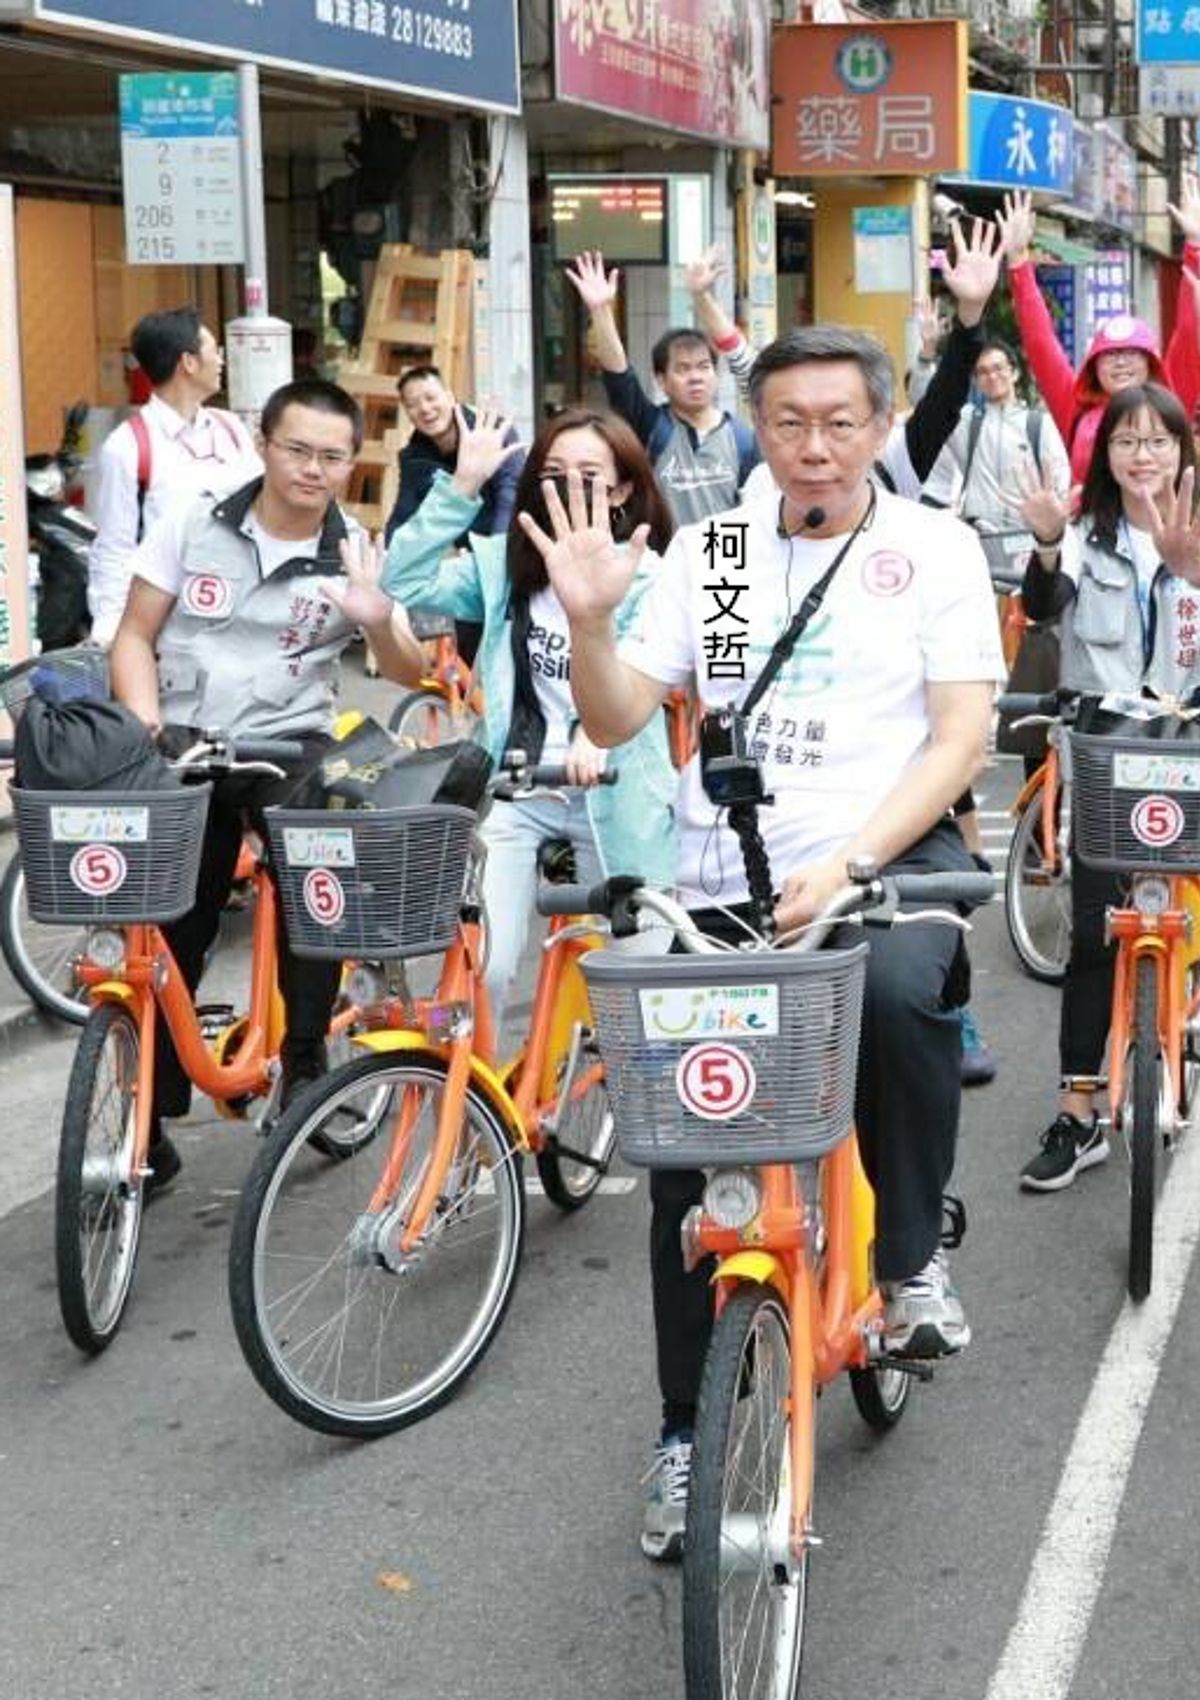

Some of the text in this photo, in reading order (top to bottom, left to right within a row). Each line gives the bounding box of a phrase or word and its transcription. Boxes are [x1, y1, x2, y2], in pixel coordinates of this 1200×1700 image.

[797, 95, 935, 162] 藥局
[158, 142, 170, 164] 2
[159, 173, 172, 196] 9
[135, 205, 174, 229] 206
[137, 237, 176, 260] 215
[874, 559, 901, 590] 5
[197, 580, 217, 607] 5
[1146, 806, 1168, 835] 5
[85, 854, 112, 884] 5
[314, 880, 334, 912] 5
[701, 1058, 734, 1103] 5
